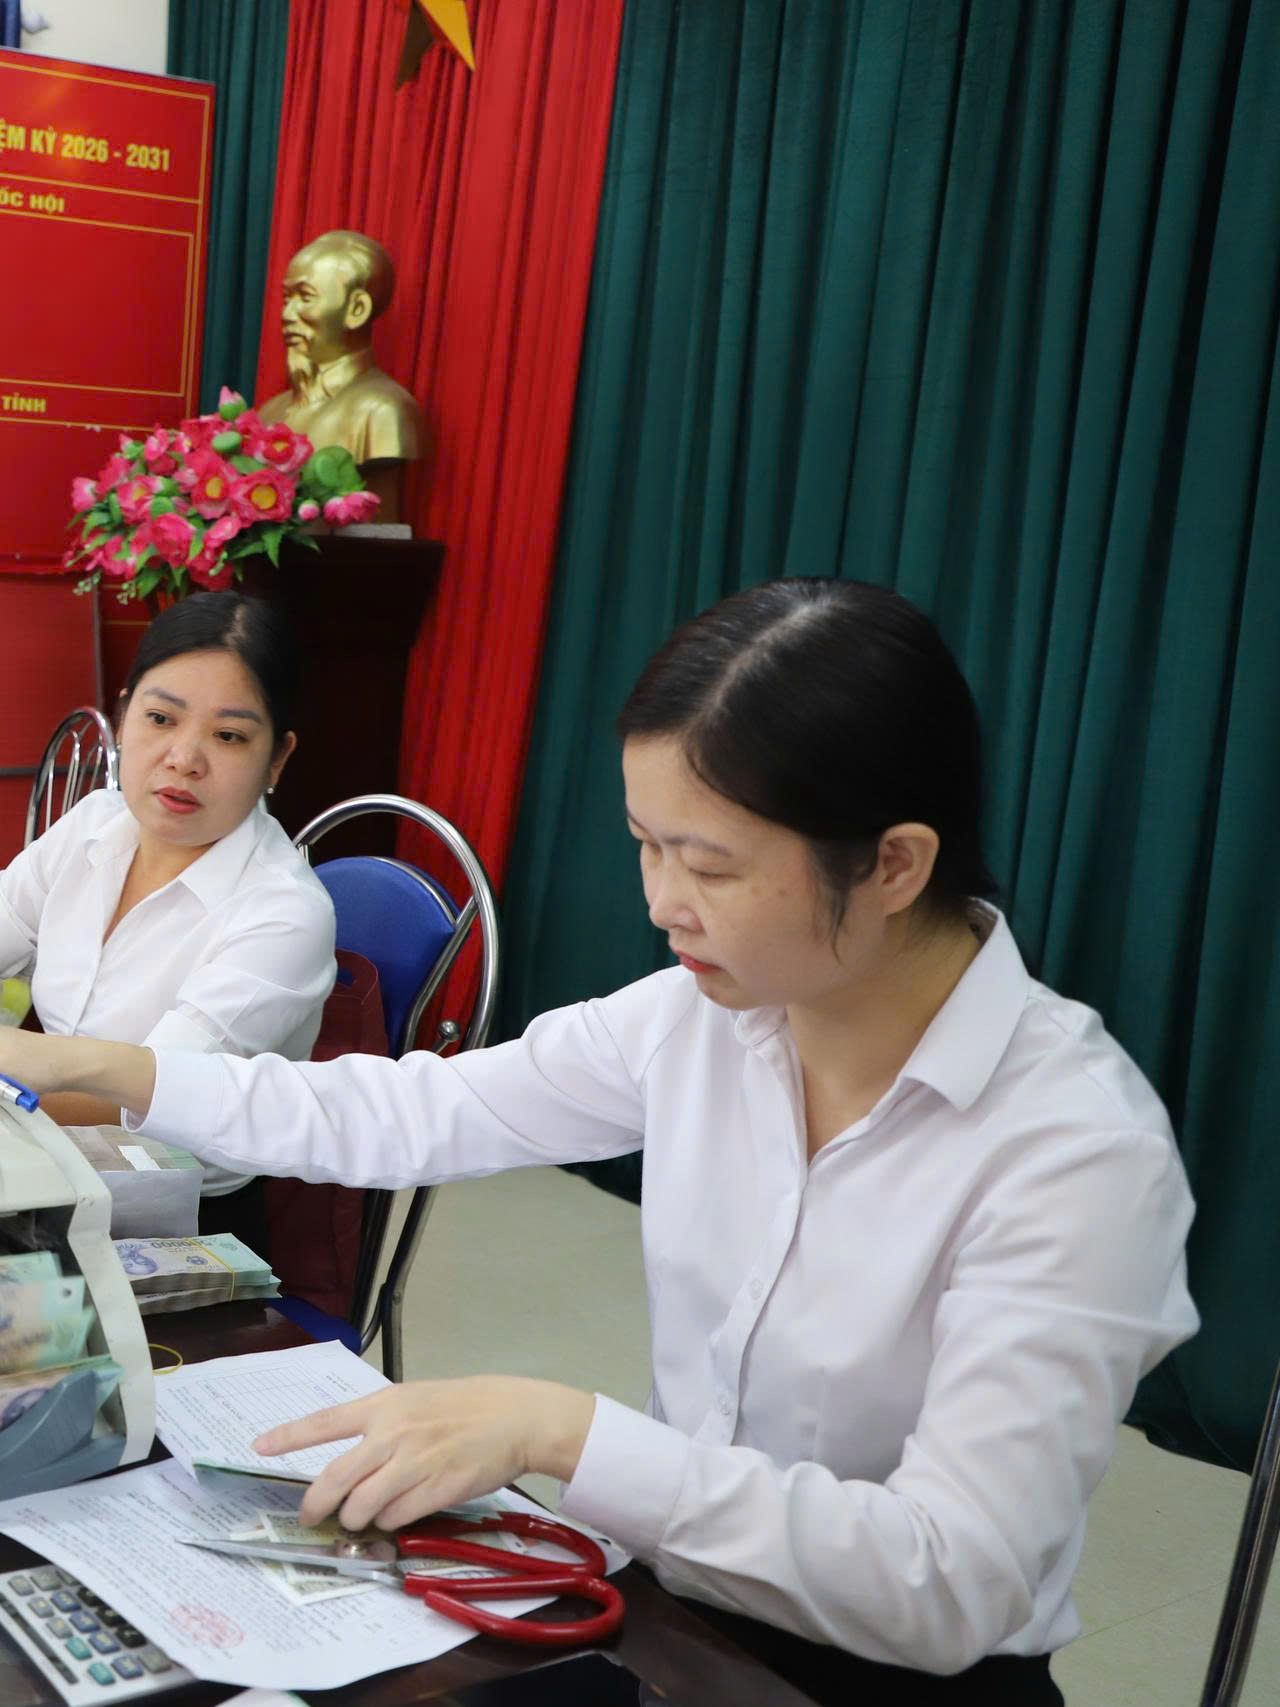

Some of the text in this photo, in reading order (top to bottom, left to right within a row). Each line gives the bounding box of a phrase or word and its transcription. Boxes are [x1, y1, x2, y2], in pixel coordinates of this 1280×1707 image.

[31, 125, 57, 154] KỲ
[61, 133, 108, 163] 2026
[126, 143, 169, 172] 2031
[30, 195, 65, 215] HỘI
[1, 393, 46, 413] TỈNH
